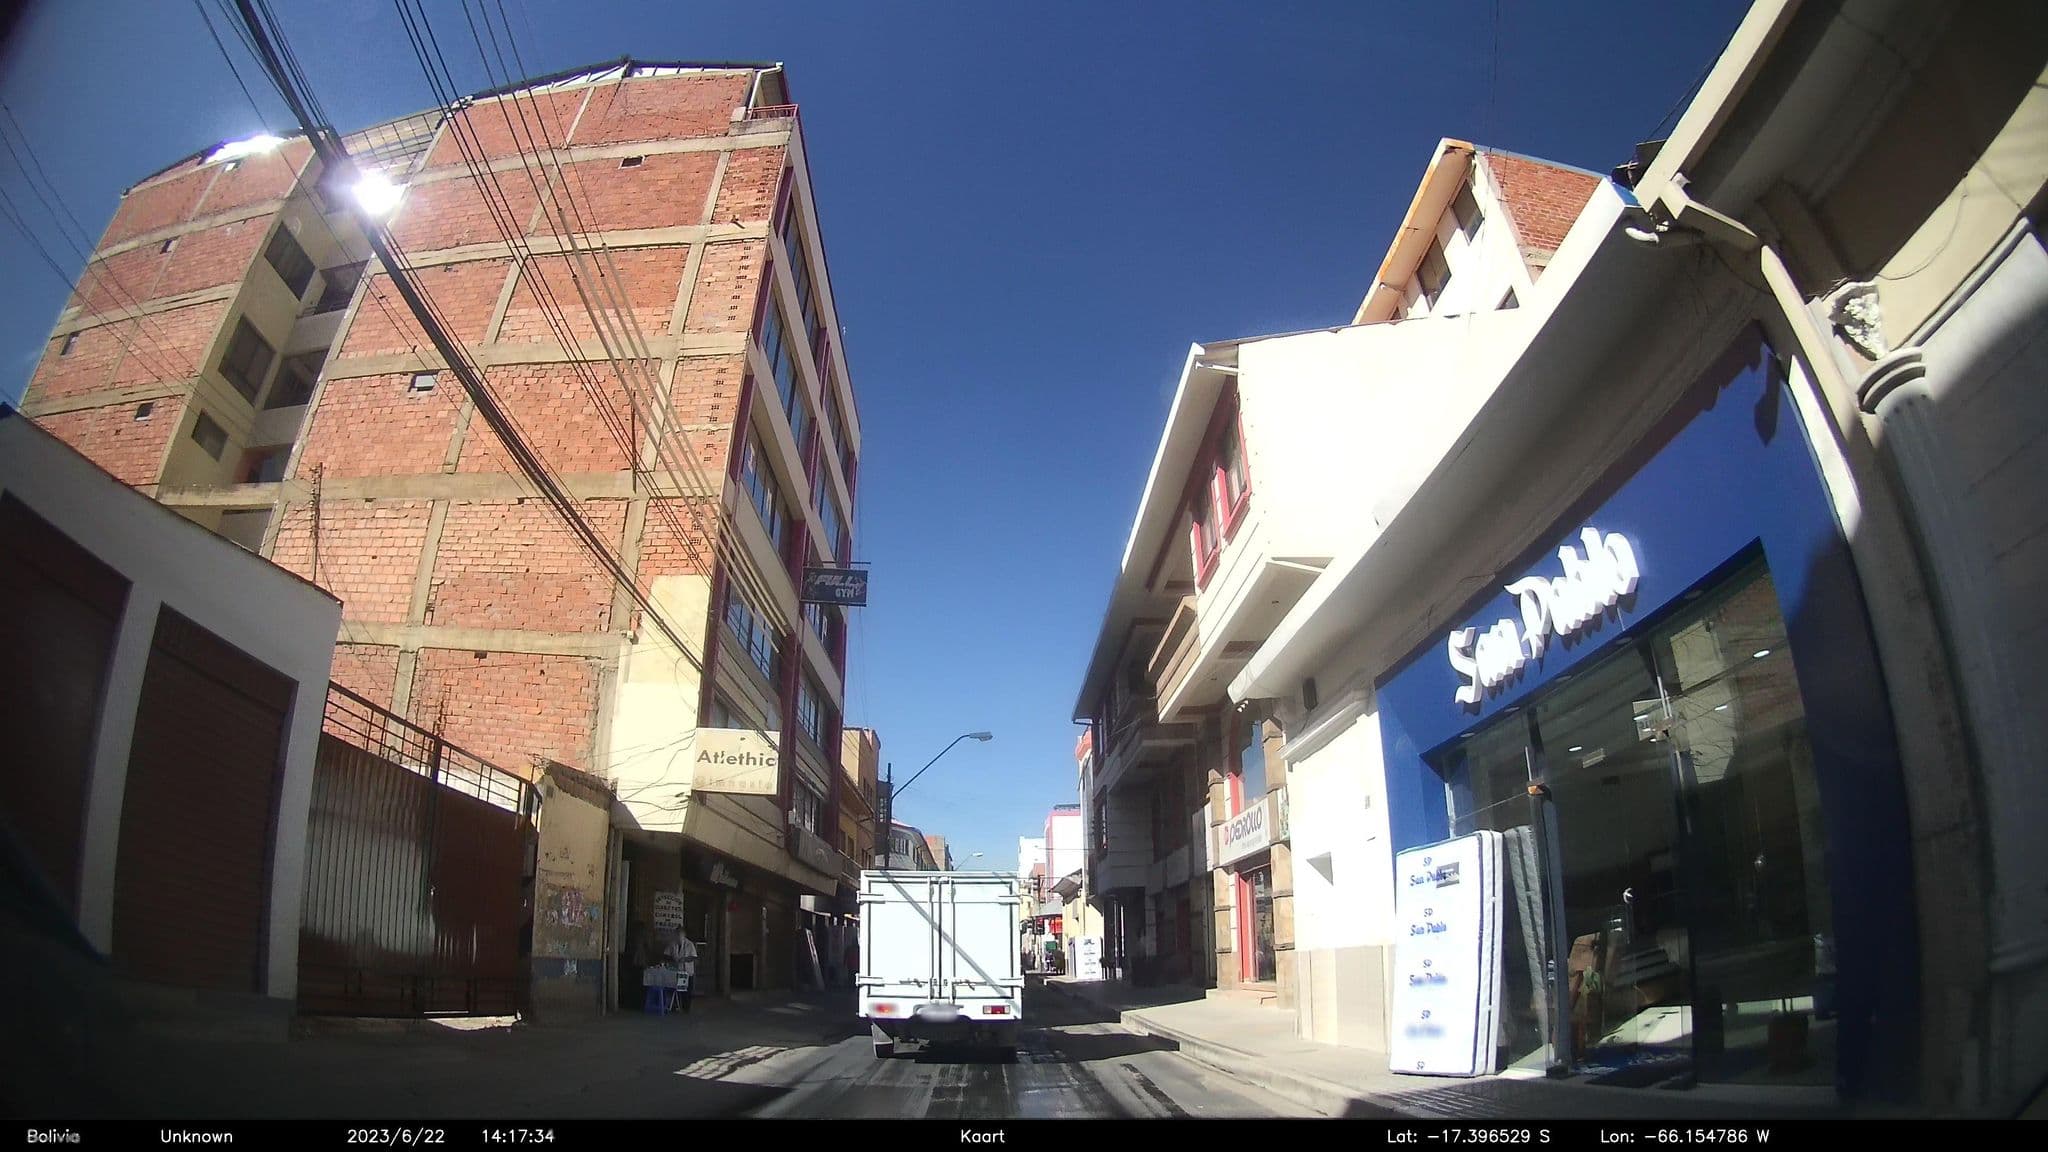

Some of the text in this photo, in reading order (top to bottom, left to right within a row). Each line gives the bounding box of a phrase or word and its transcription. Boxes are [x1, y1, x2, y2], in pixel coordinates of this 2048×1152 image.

[835, 588, 854, 598] GYM
[1448, 527, 1640, 703] San Pablo
[1410, 874, 1425, 886] San
